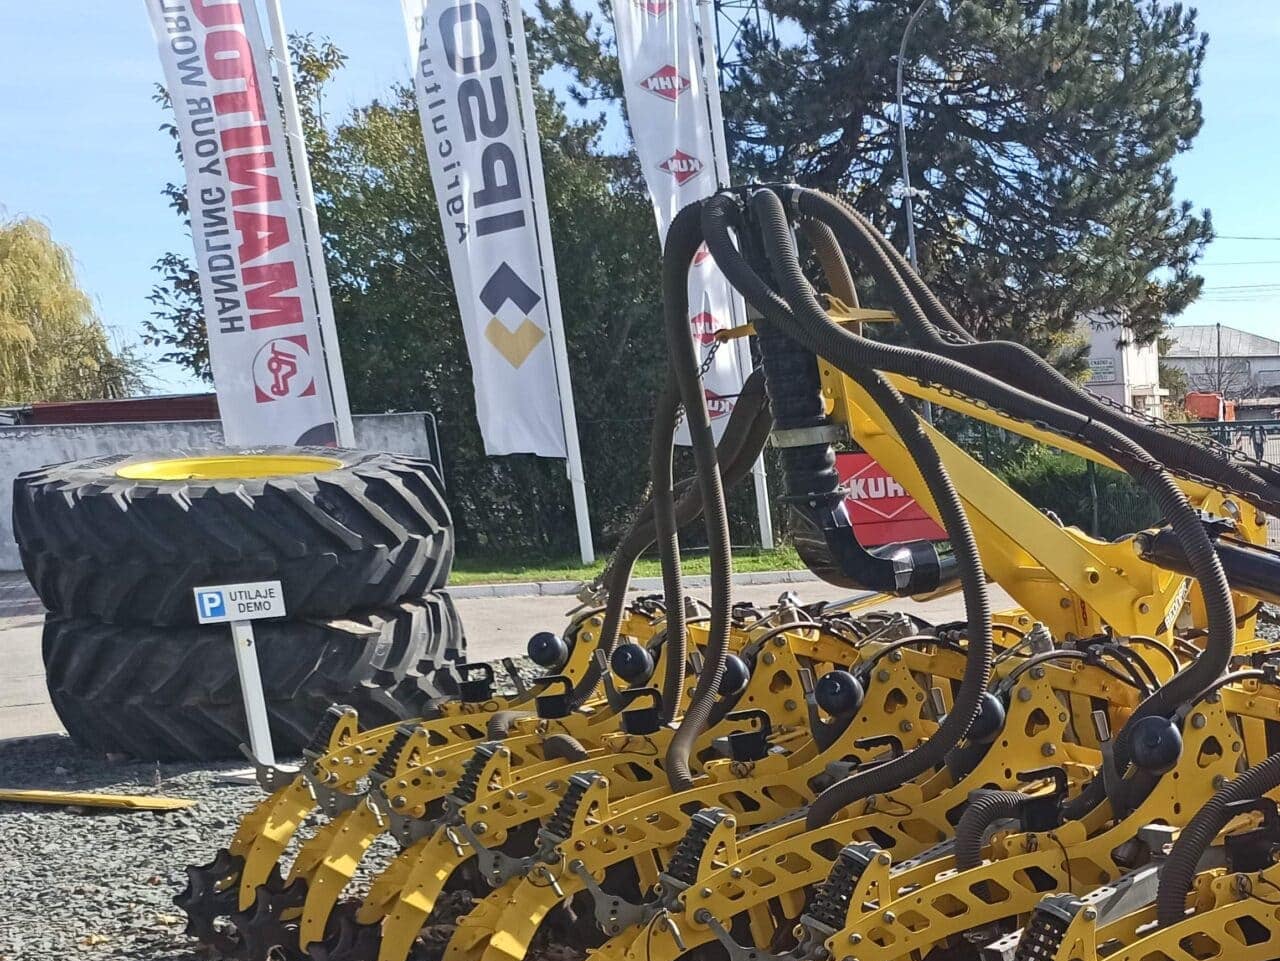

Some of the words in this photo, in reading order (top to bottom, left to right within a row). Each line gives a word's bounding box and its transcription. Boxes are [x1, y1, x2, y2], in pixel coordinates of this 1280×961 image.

[849, 476, 910, 500] KUH
[229, 588, 277, 602] UTILAJE
[202, 593, 221, 617] P
[238, 601, 272, 613] DEMO
